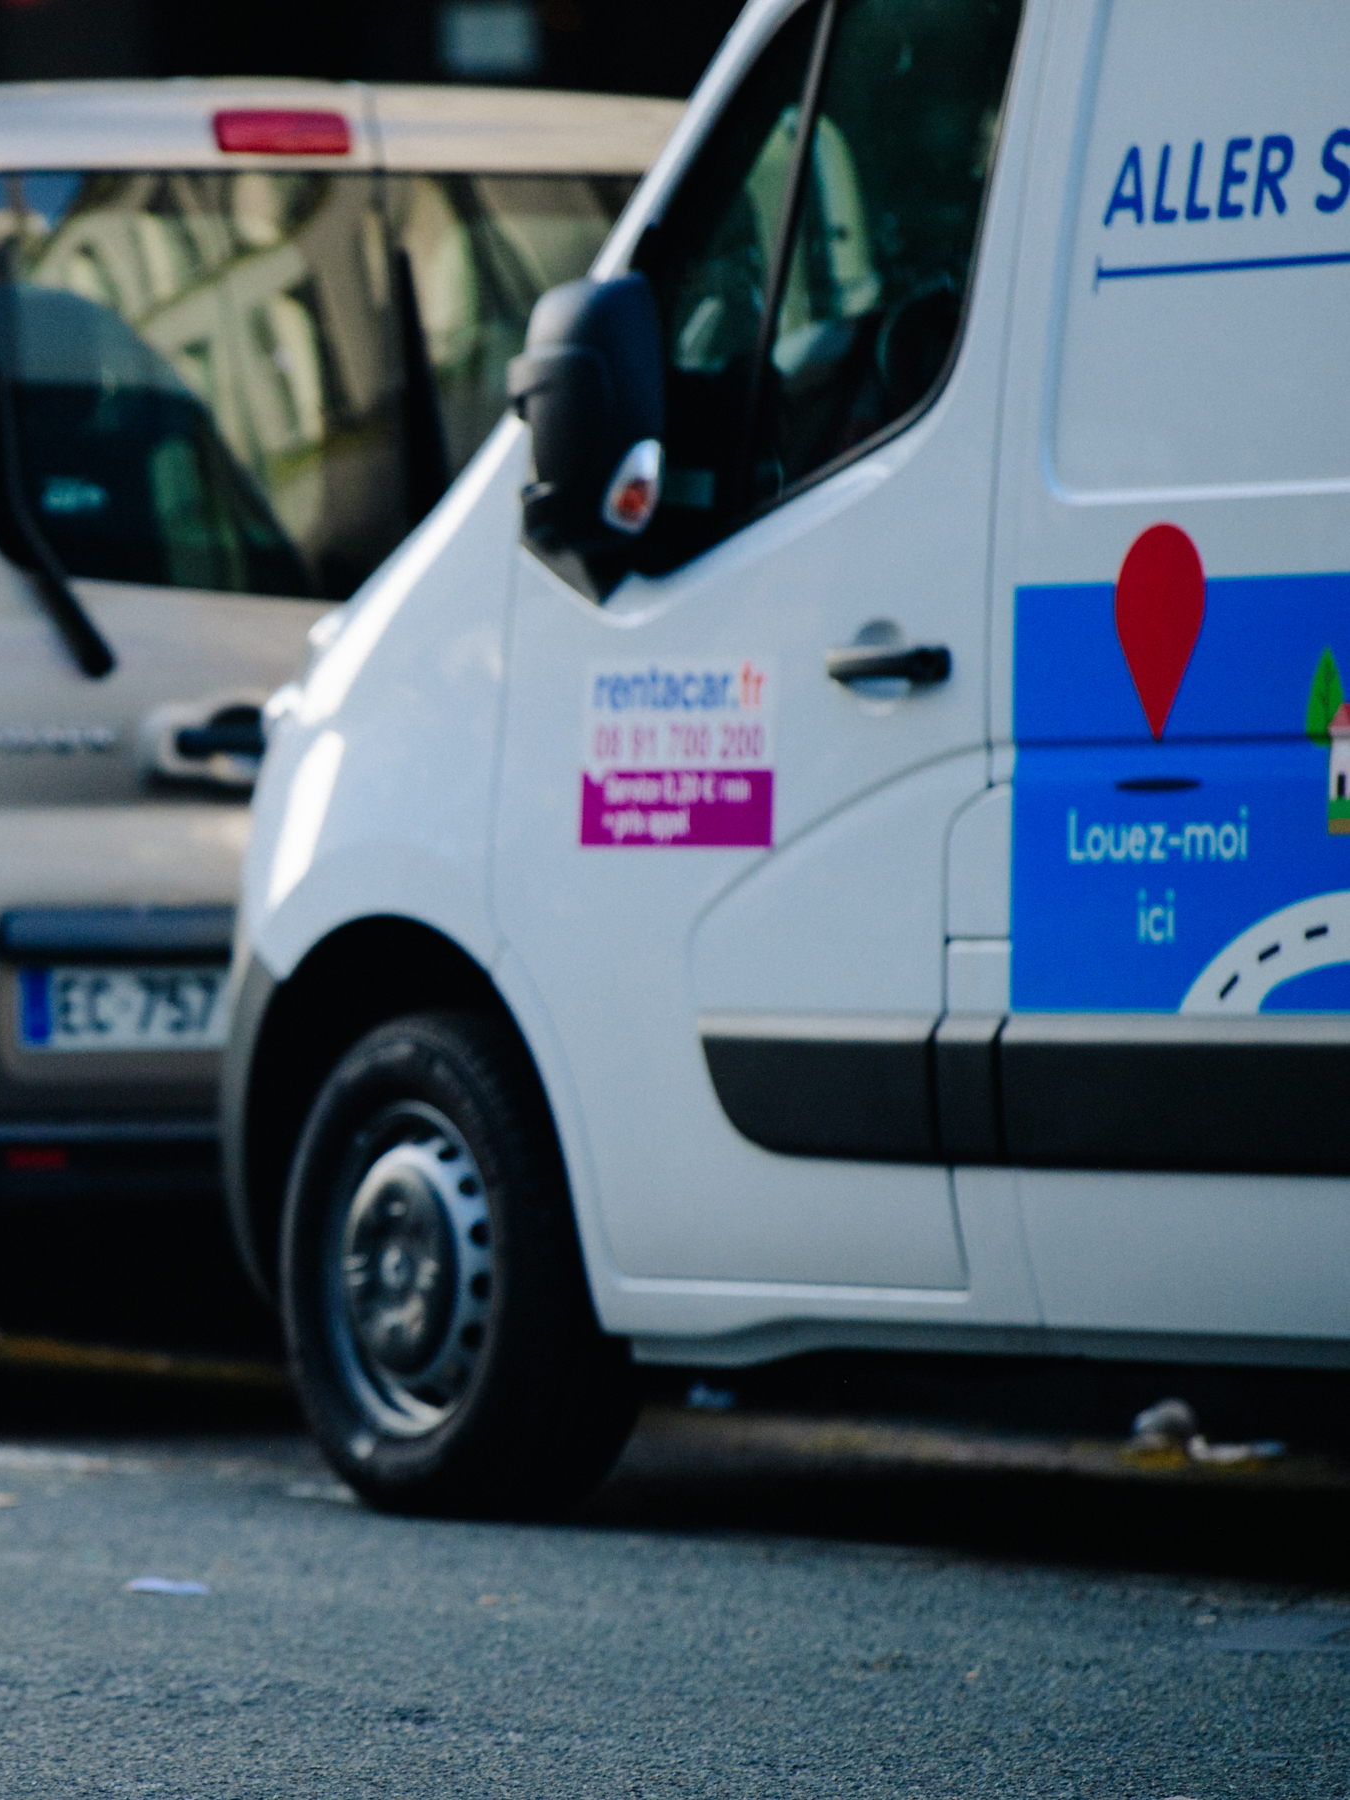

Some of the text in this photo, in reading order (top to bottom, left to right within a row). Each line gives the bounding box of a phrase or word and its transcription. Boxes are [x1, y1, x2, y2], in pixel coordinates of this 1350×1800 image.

[1103, 134, 1295, 228] ALLER
[593, 658, 767, 711] rentacar.fr
[669, 723, 713, 758] 700
[720, 722, 765, 758] 200
[1067, 804, 1248, 864] Louez-moi
[1138, 887, 1176, 944] ici
